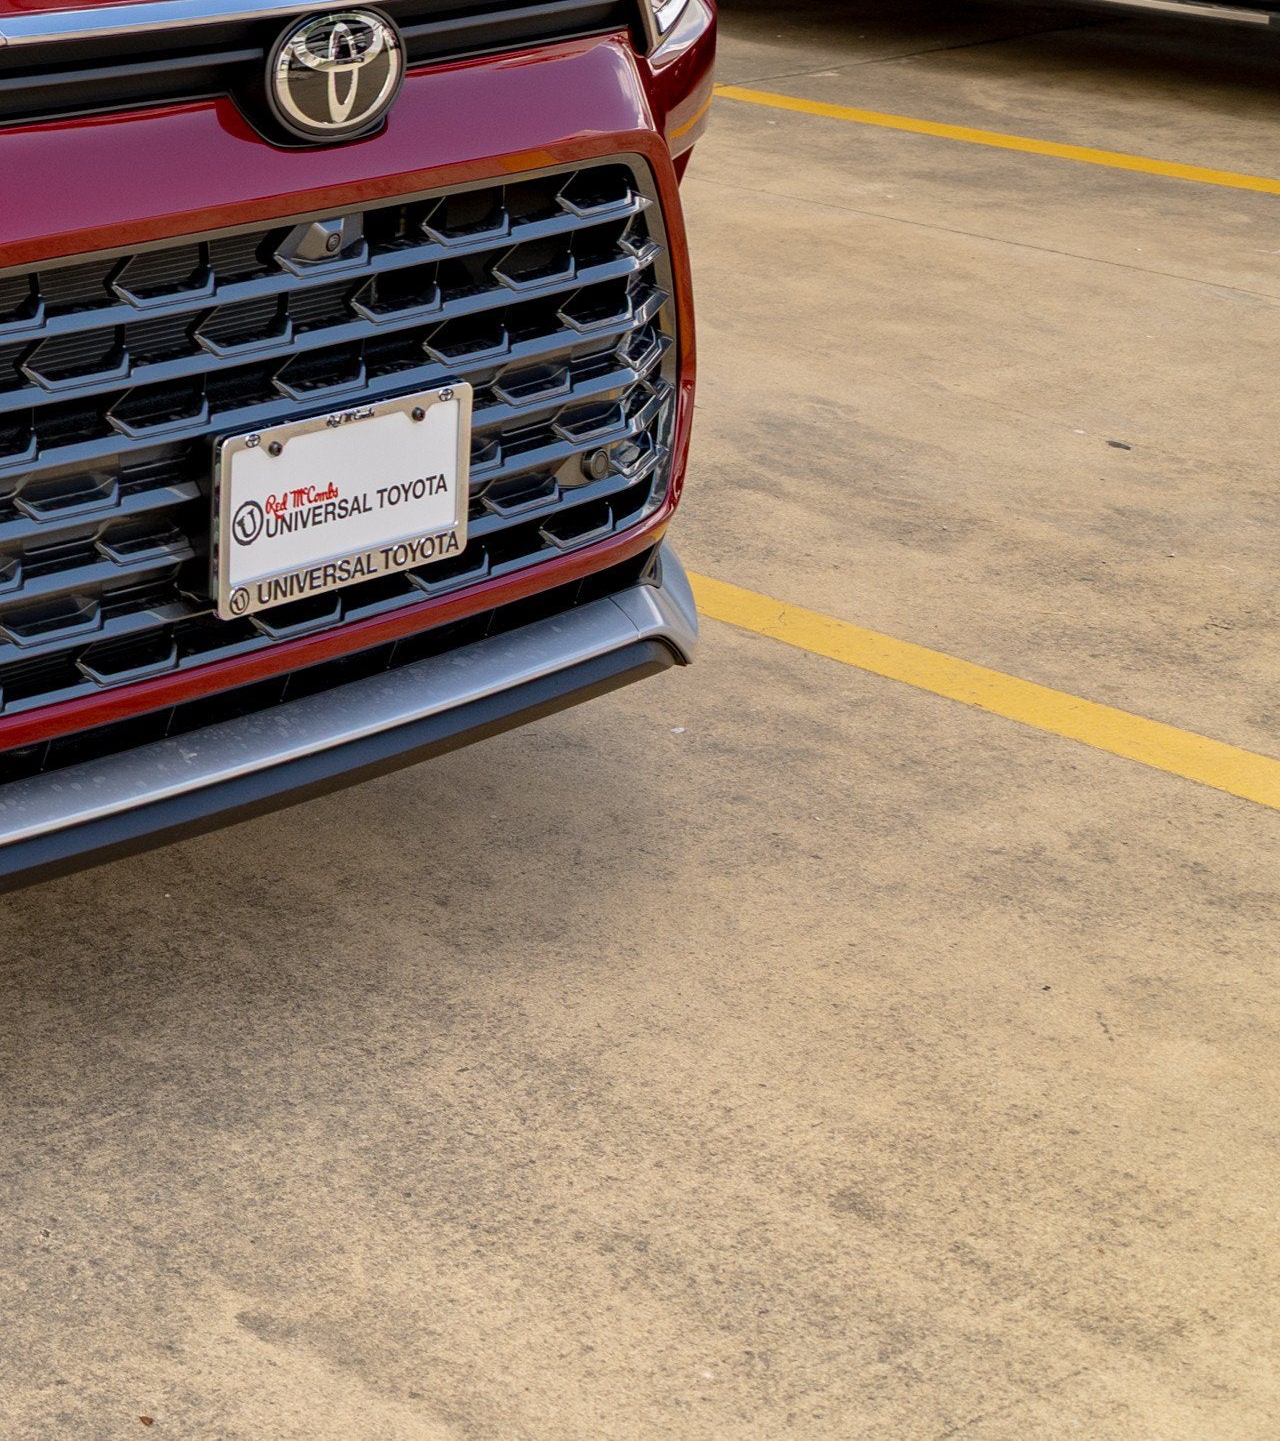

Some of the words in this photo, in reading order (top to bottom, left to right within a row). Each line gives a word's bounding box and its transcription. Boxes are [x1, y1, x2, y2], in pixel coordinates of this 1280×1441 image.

[265, 491, 288, 519] Red
[290, 482, 339, 508] McCombs
[265, 493, 373, 538] UNIVERSAL
[377, 473, 448, 509] TOYOTA
[257, 553, 378, 604] UNIVERSAL
[380, 531, 459, 570] TOYOTA
